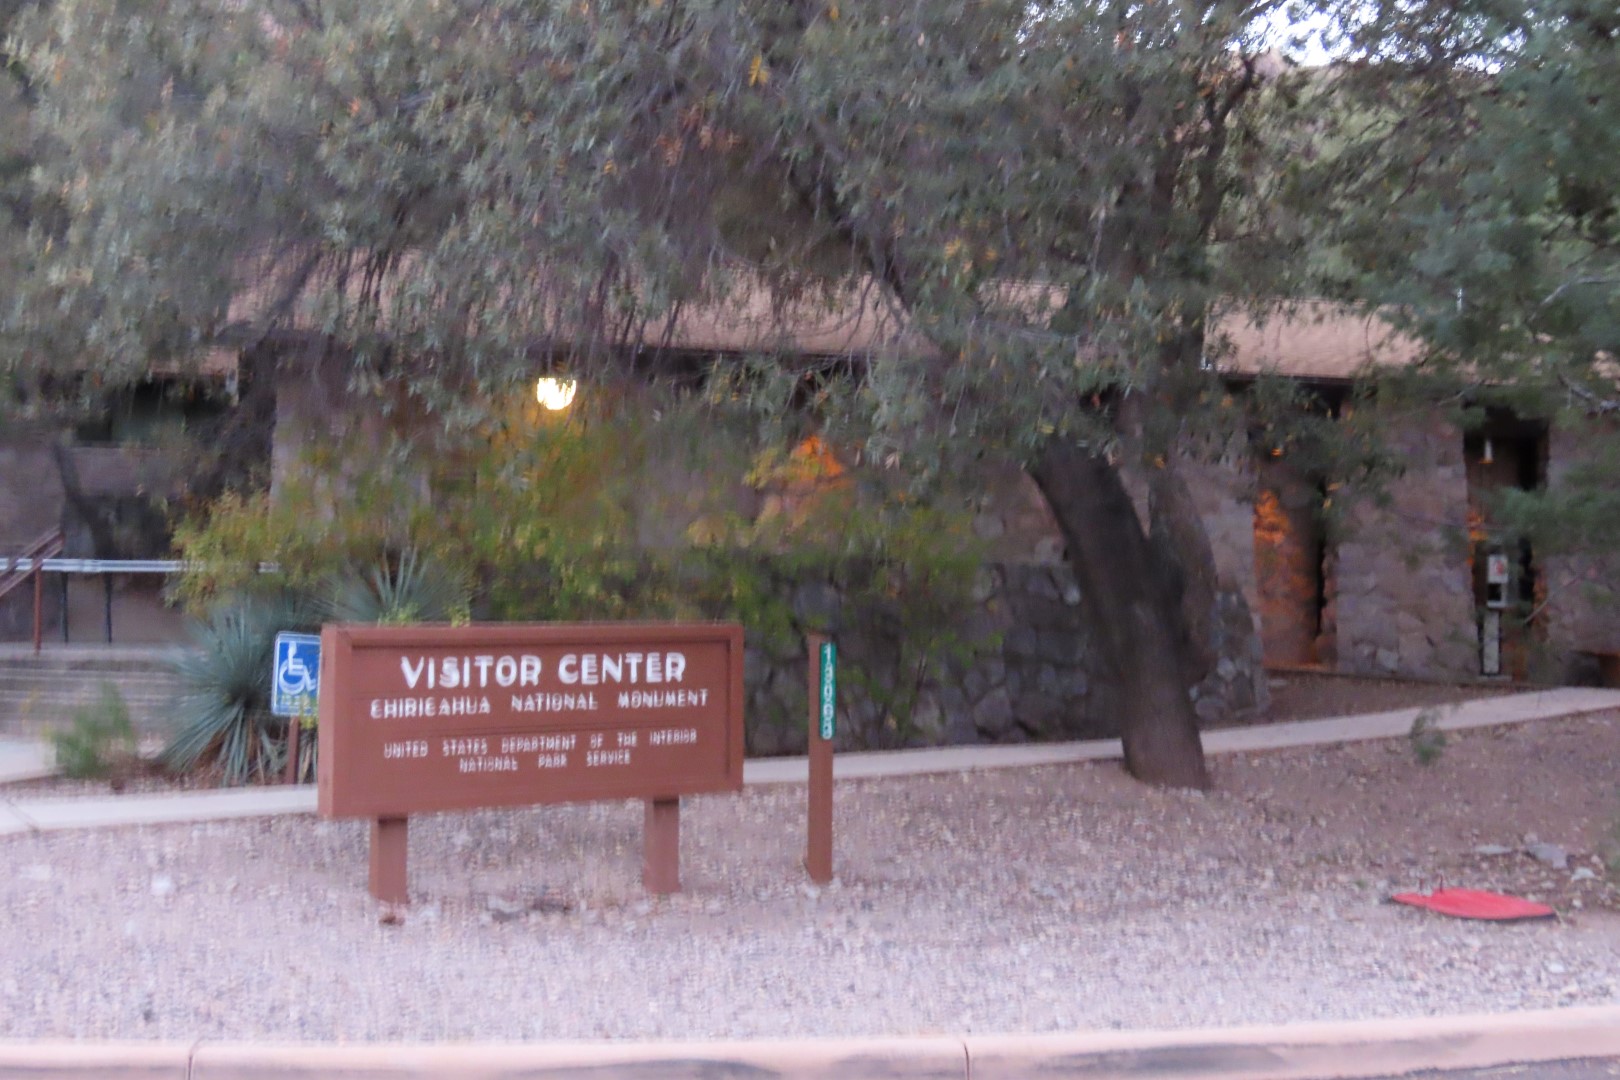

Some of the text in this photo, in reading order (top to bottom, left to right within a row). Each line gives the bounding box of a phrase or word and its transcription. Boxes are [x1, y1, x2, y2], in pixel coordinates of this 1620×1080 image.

[401, 652, 687, 689] VISITOR CENTER
[370, 689, 709, 719] CHIRICAHUA NATIONAL MONUMENT
[384, 728, 697, 759] UNITED STATES DEPARTMENT OF THE INTERIOR
[459, 749, 631, 773] NATIONAL PARK SERVICE
